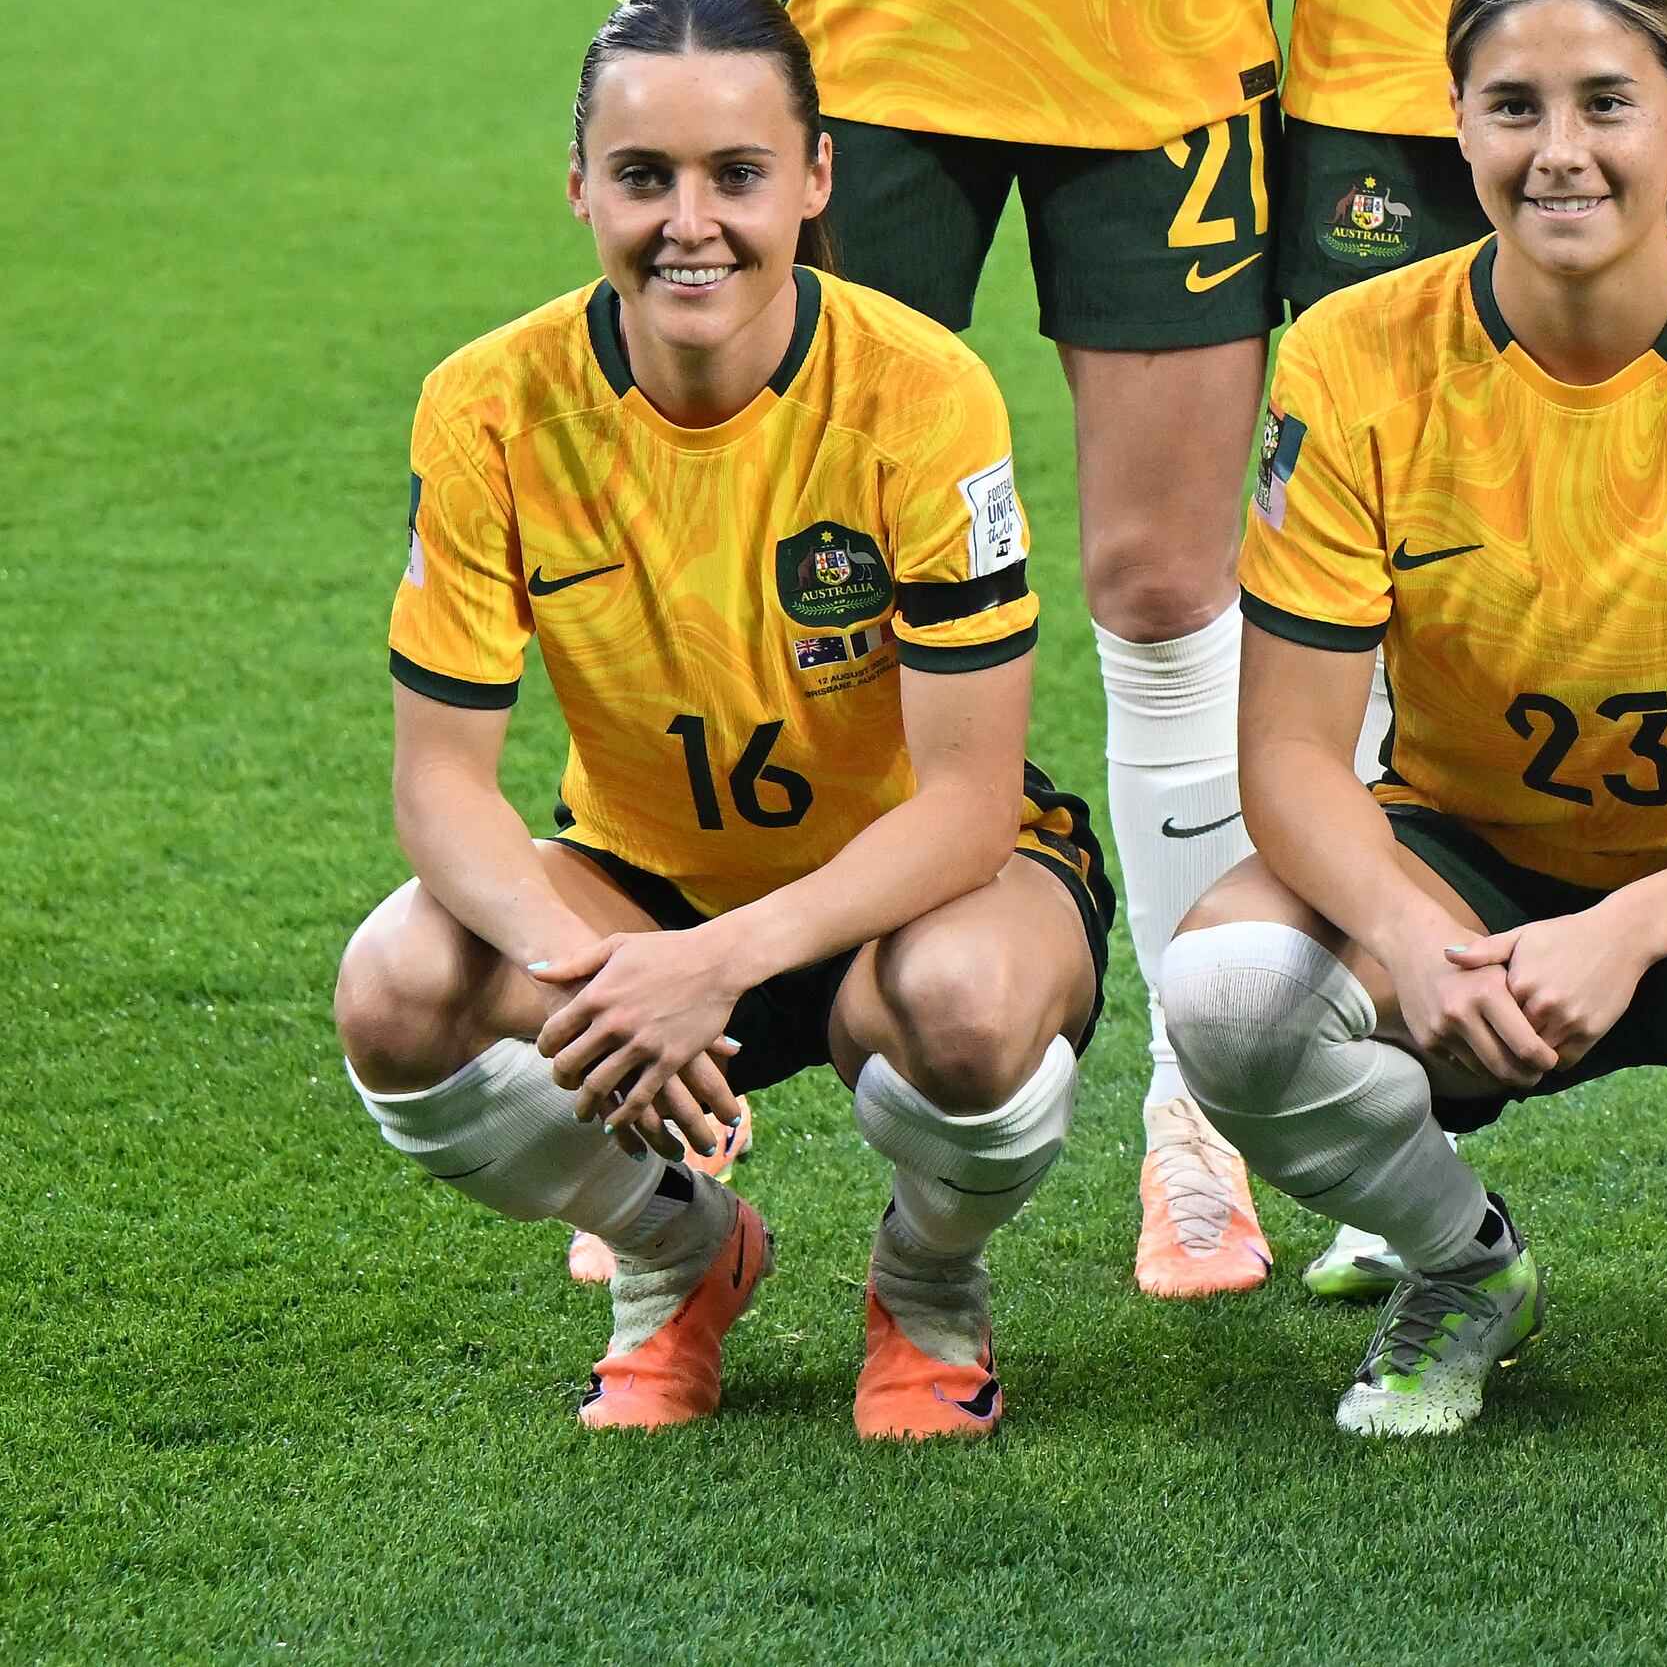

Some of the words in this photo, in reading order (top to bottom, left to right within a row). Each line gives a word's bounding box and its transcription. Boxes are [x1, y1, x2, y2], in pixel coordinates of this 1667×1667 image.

[1163, 103, 1269, 248] 21
[1333, 226, 1401, 245] AUSTRALIA
[801, 582, 875, 602] AUSTRALIA
[817, 677, 830, 686] 12
[830, 667, 869, 683] AUGUST
[665, 713, 814, 831] 16
